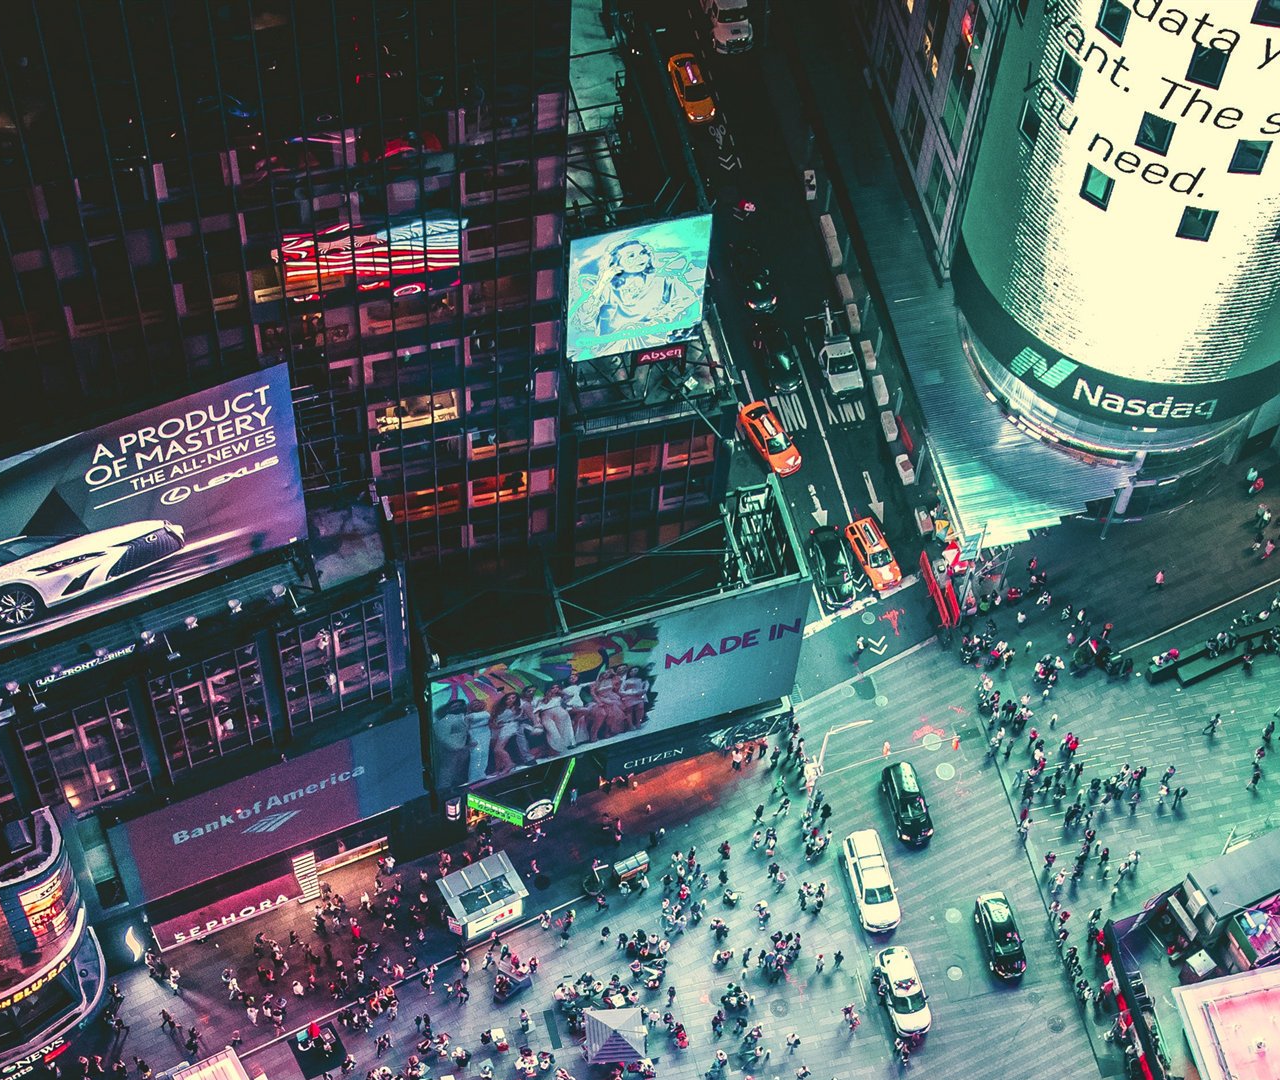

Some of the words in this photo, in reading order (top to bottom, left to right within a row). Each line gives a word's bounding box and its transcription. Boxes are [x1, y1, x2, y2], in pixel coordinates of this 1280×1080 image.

[1046, 1, 1131, 93] want.
[1158, 77, 1244, 130] The
[1023, 62, 1080, 136] you
[1087, 133, 1207, 199] need.
[92, 443, 115, 465] A
[119, 385, 271, 450] PRODUCT
[765, 392, 808, 433] ONL
[1072, 378, 1219, 420] Nasdaq
[84, 457, 128, 486] OF
[135, 405, 273, 471] MASTERY
[129, 473, 167, 492] THE
[169, 441, 250, 479] ALL-NEW
[254, 430, 277, 449] ES
[193, 455, 280, 493] LEXUS
[665, 628, 761, 670] MADE
[768, 618, 802, 642] IN
[623, 746, 685, 770] CITIZEN
[172, 813, 236, 846] Bank
[237, 800, 264, 821] of
[265, 764, 366, 811] America
[174, 893, 290, 944] SEPHORA
[16, 1037, 65, 1069] NEWS
